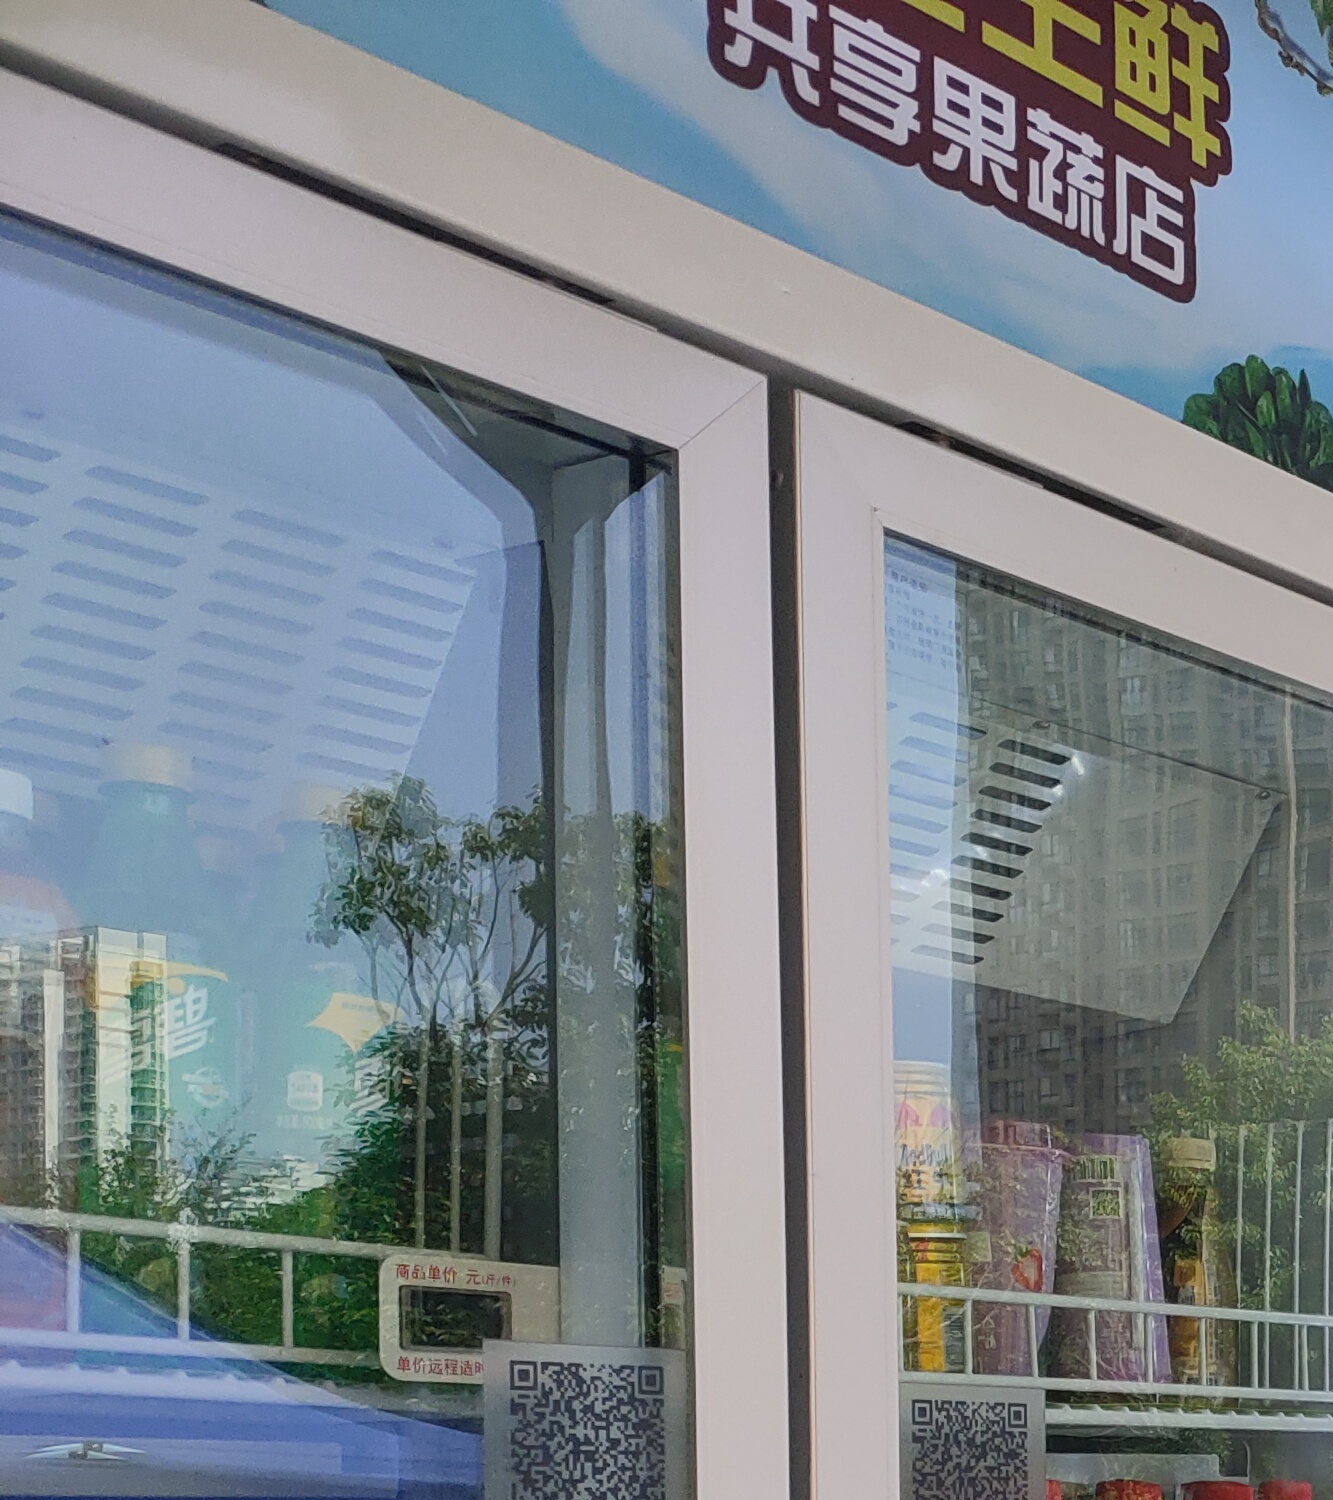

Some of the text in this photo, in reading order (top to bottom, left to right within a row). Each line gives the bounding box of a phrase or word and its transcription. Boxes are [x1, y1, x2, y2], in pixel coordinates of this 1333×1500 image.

[724, 0, 1185, 285] 共享果蔬店
[396, 1263, 457, 1284] 商品单价
